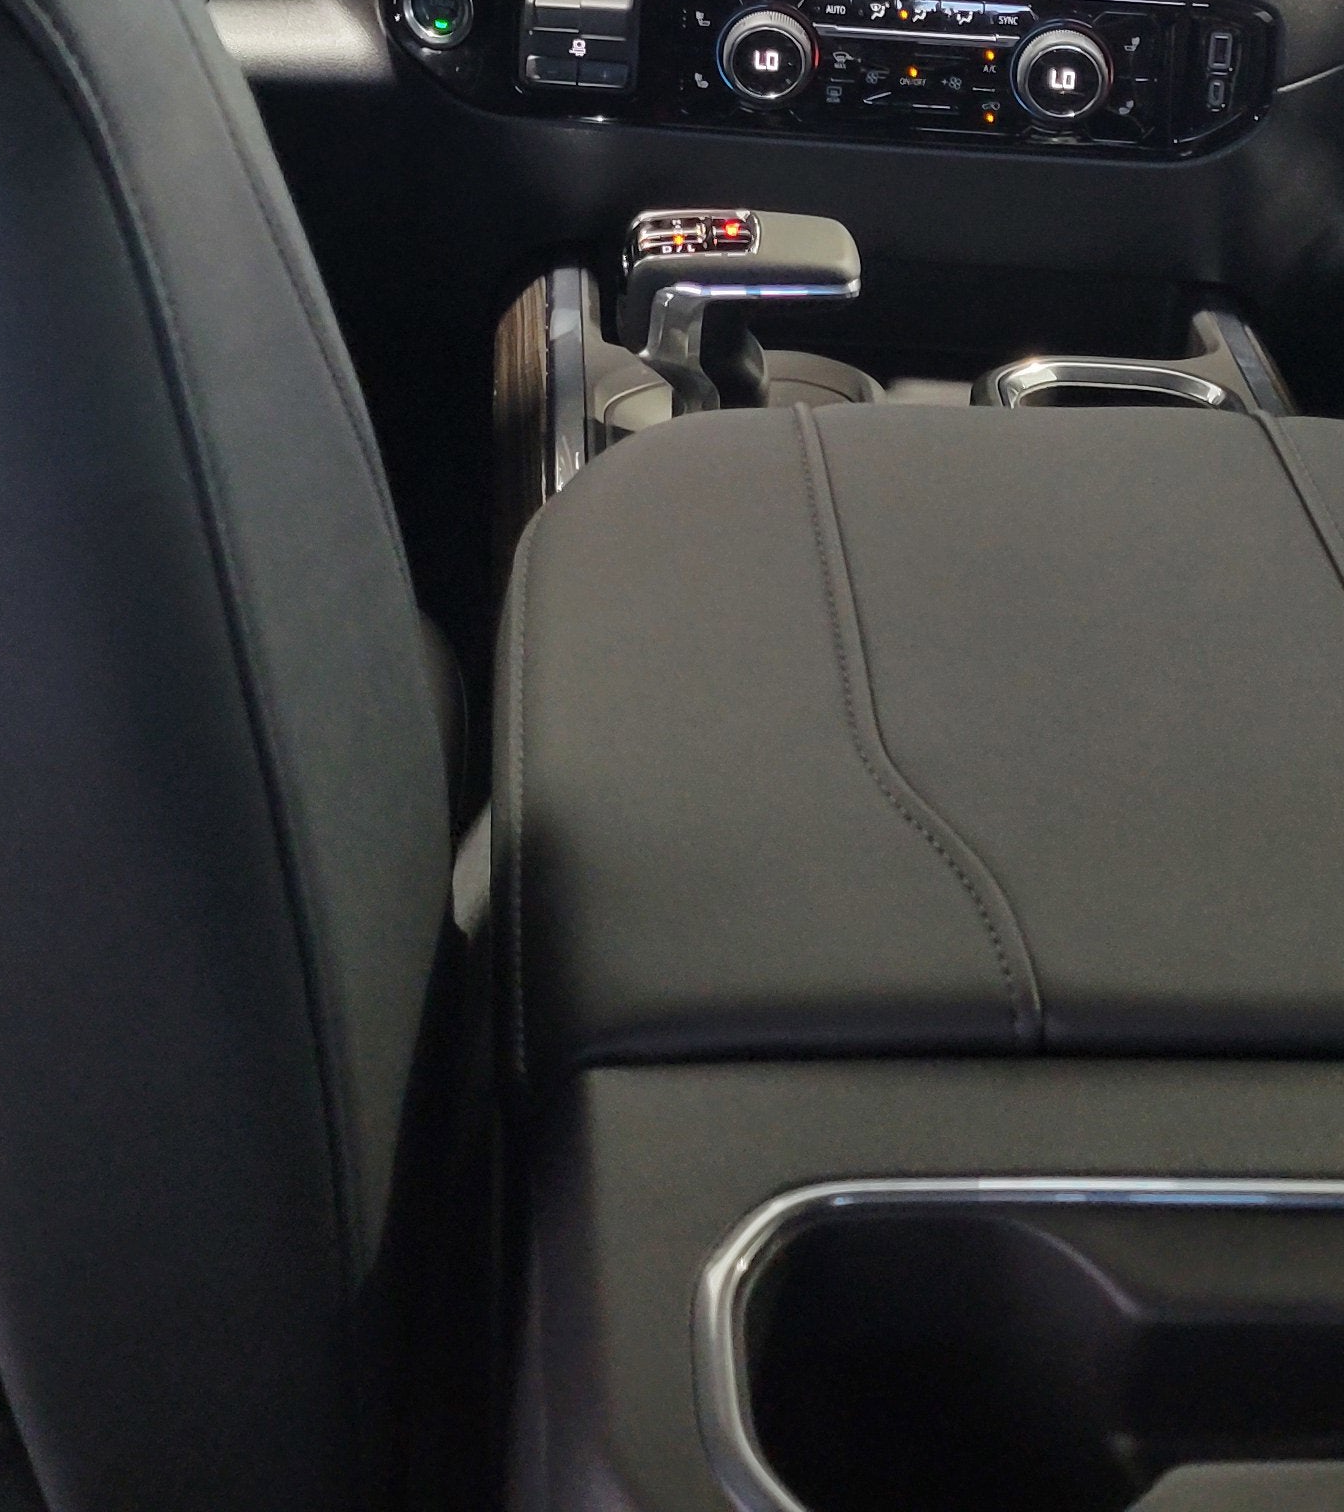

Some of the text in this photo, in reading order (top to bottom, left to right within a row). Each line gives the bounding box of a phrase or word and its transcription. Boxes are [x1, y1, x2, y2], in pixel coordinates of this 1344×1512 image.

[825, 4, 846, 15] AUTO
[998, 15, 1019, 26] SYNC
[983, 64, 997, 73] A/C
